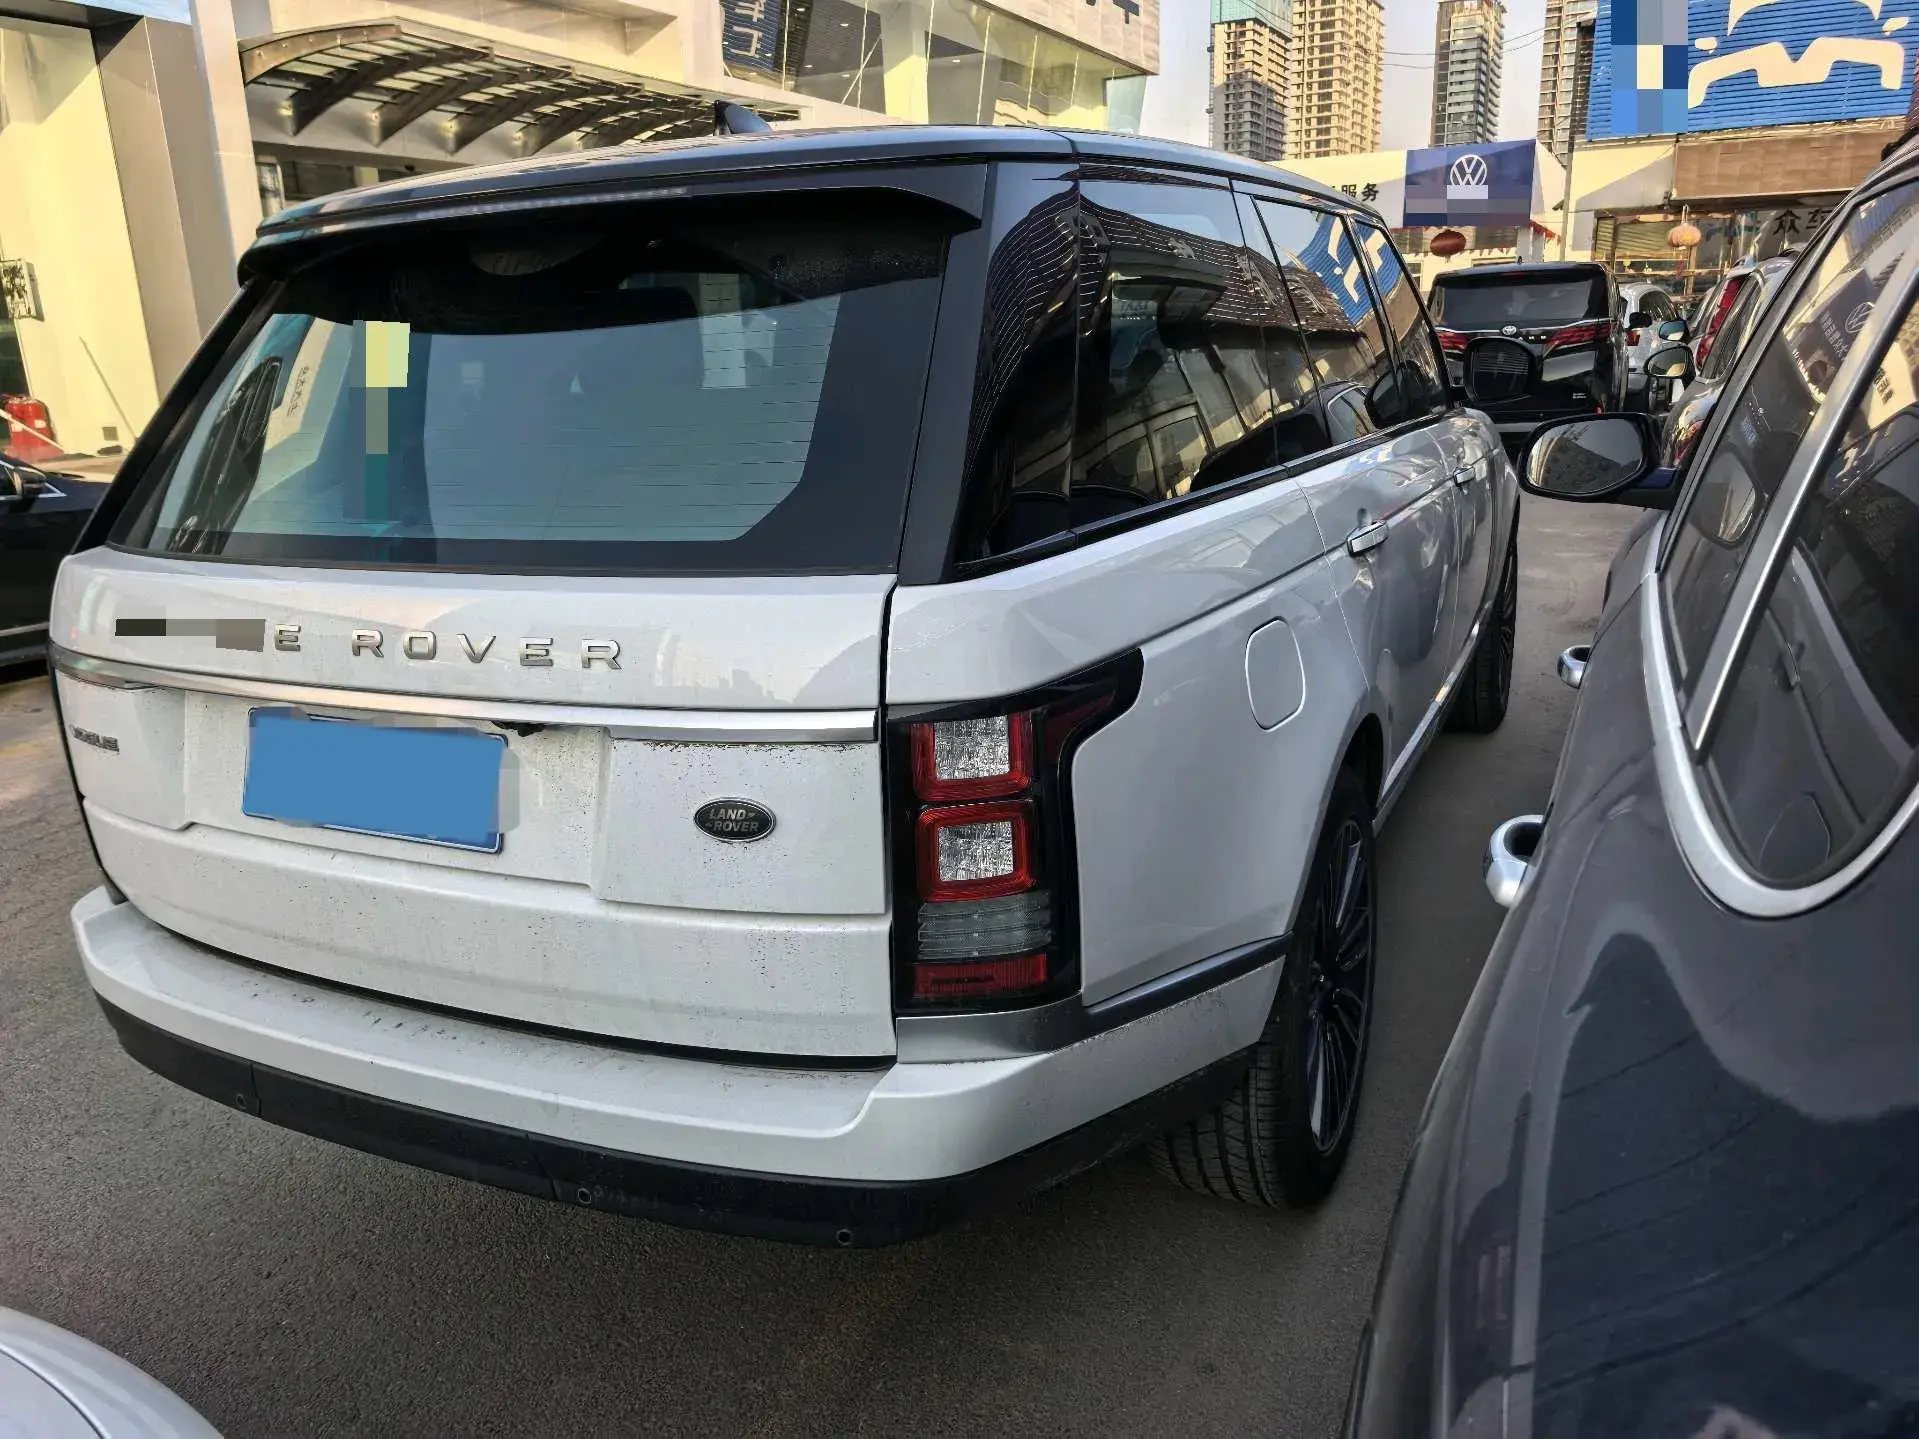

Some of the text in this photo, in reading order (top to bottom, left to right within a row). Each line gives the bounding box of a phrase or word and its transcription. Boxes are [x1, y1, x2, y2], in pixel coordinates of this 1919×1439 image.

[1332, 183, 1379, 201] 服务
[351, 629, 623, 670] ROVER
[709, 808, 747, 820] LAND
[713, 820, 759, 832] ROVER
